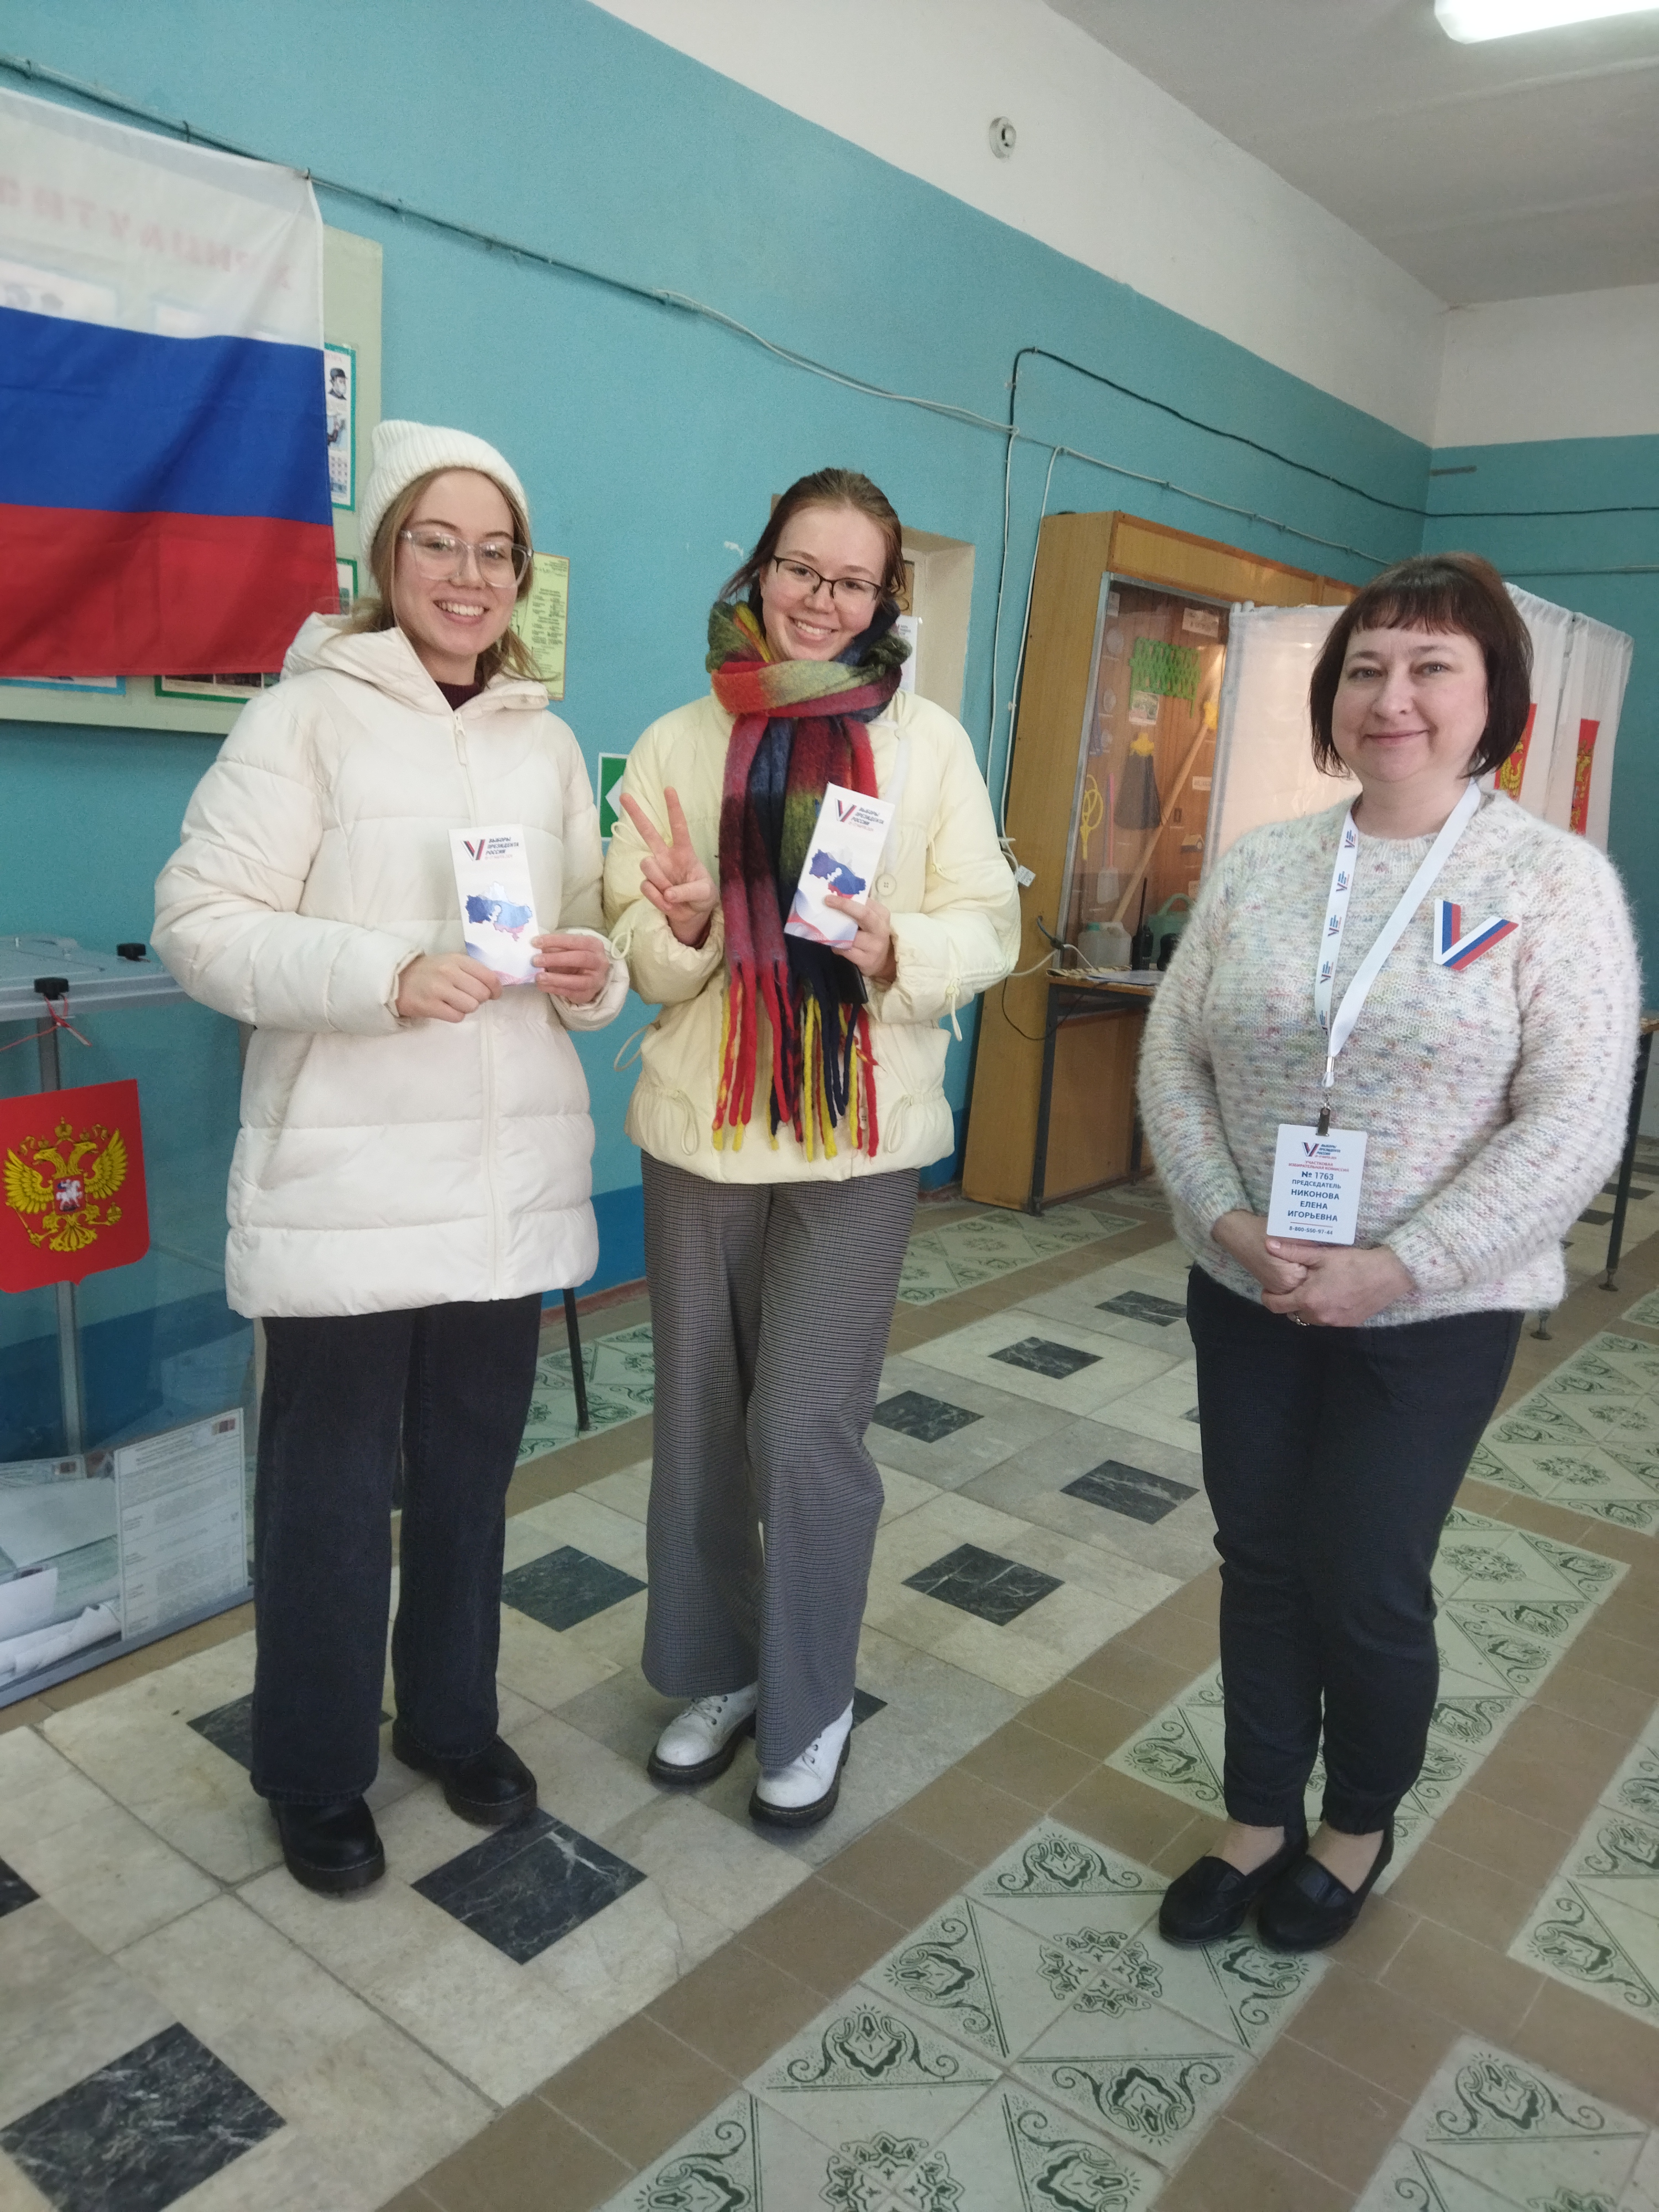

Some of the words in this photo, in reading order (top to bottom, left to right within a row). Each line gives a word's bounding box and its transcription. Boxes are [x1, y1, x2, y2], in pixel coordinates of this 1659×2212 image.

[1315, 1172, 1334, 1181] 1763
[1292, 1179, 1342, 1189] ПРЕДСЕДАТЕЛЬ
[1291, 1188, 1340, 1200] НИКОНОВА
[1300, 1201, 1328, 1210] ЕЛЕНА
[1287, 1210, 1338, 1222] ИГОРЬЕВНА
